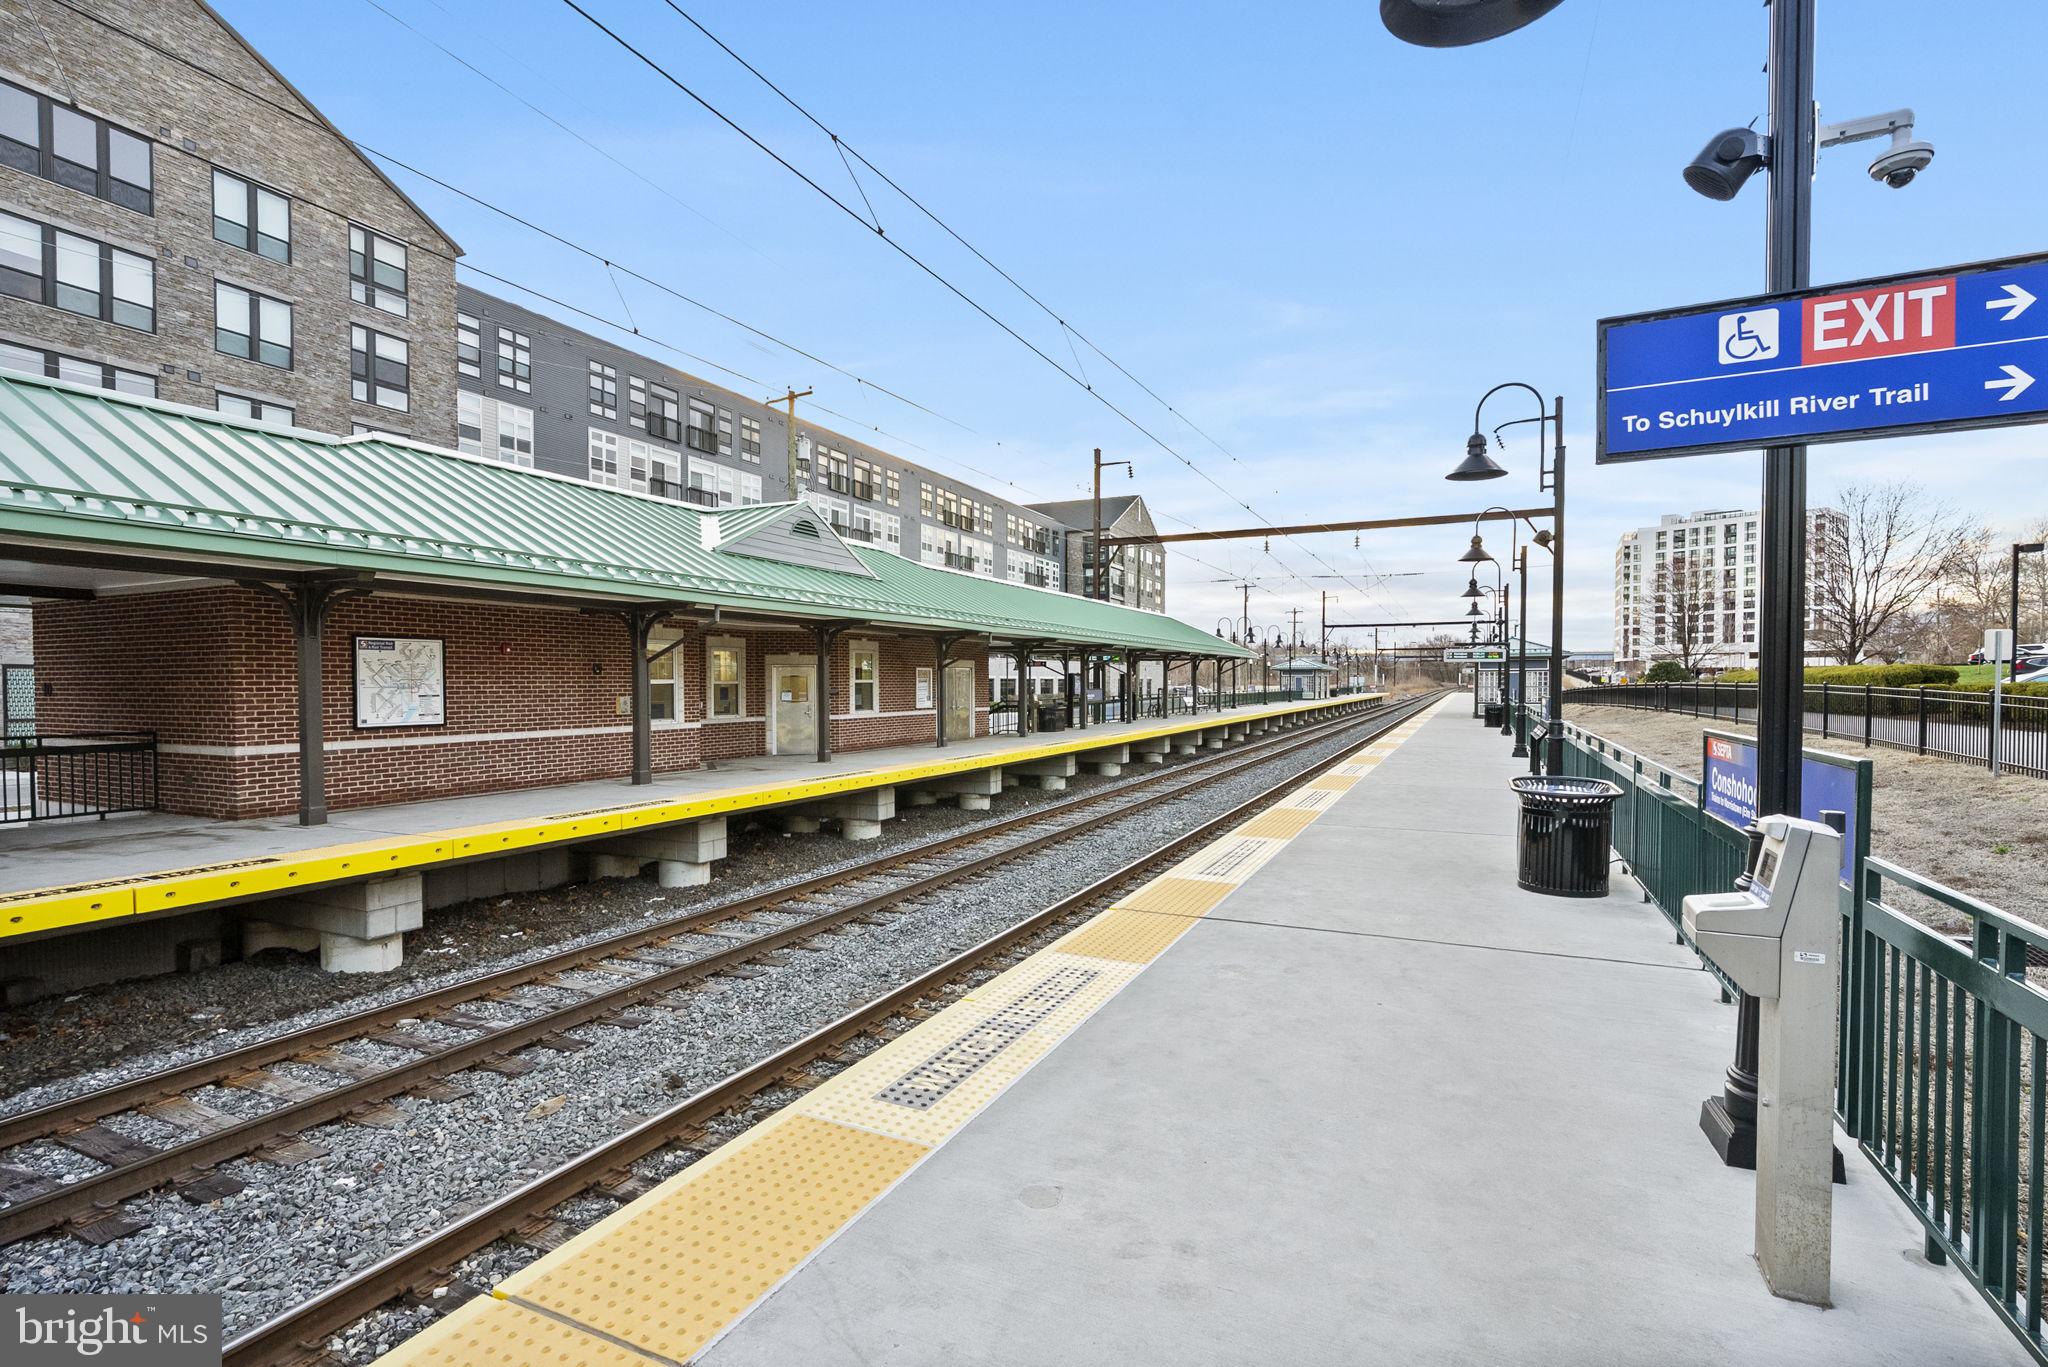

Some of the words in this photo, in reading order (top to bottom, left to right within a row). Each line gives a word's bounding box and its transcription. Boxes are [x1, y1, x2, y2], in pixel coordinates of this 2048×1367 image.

[1813, 285, 1948, 351] EXIT
[1622, 414, 1650, 433] To
[1659, 399, 1780, 430] Schuylkill
[1790, 391, 1860, 415] River
[1869, 383, 1929, 407] Trail
[1717, 743, 1732, 759] SEPTA
[900, 1028, 1016, 1091] WATCH
